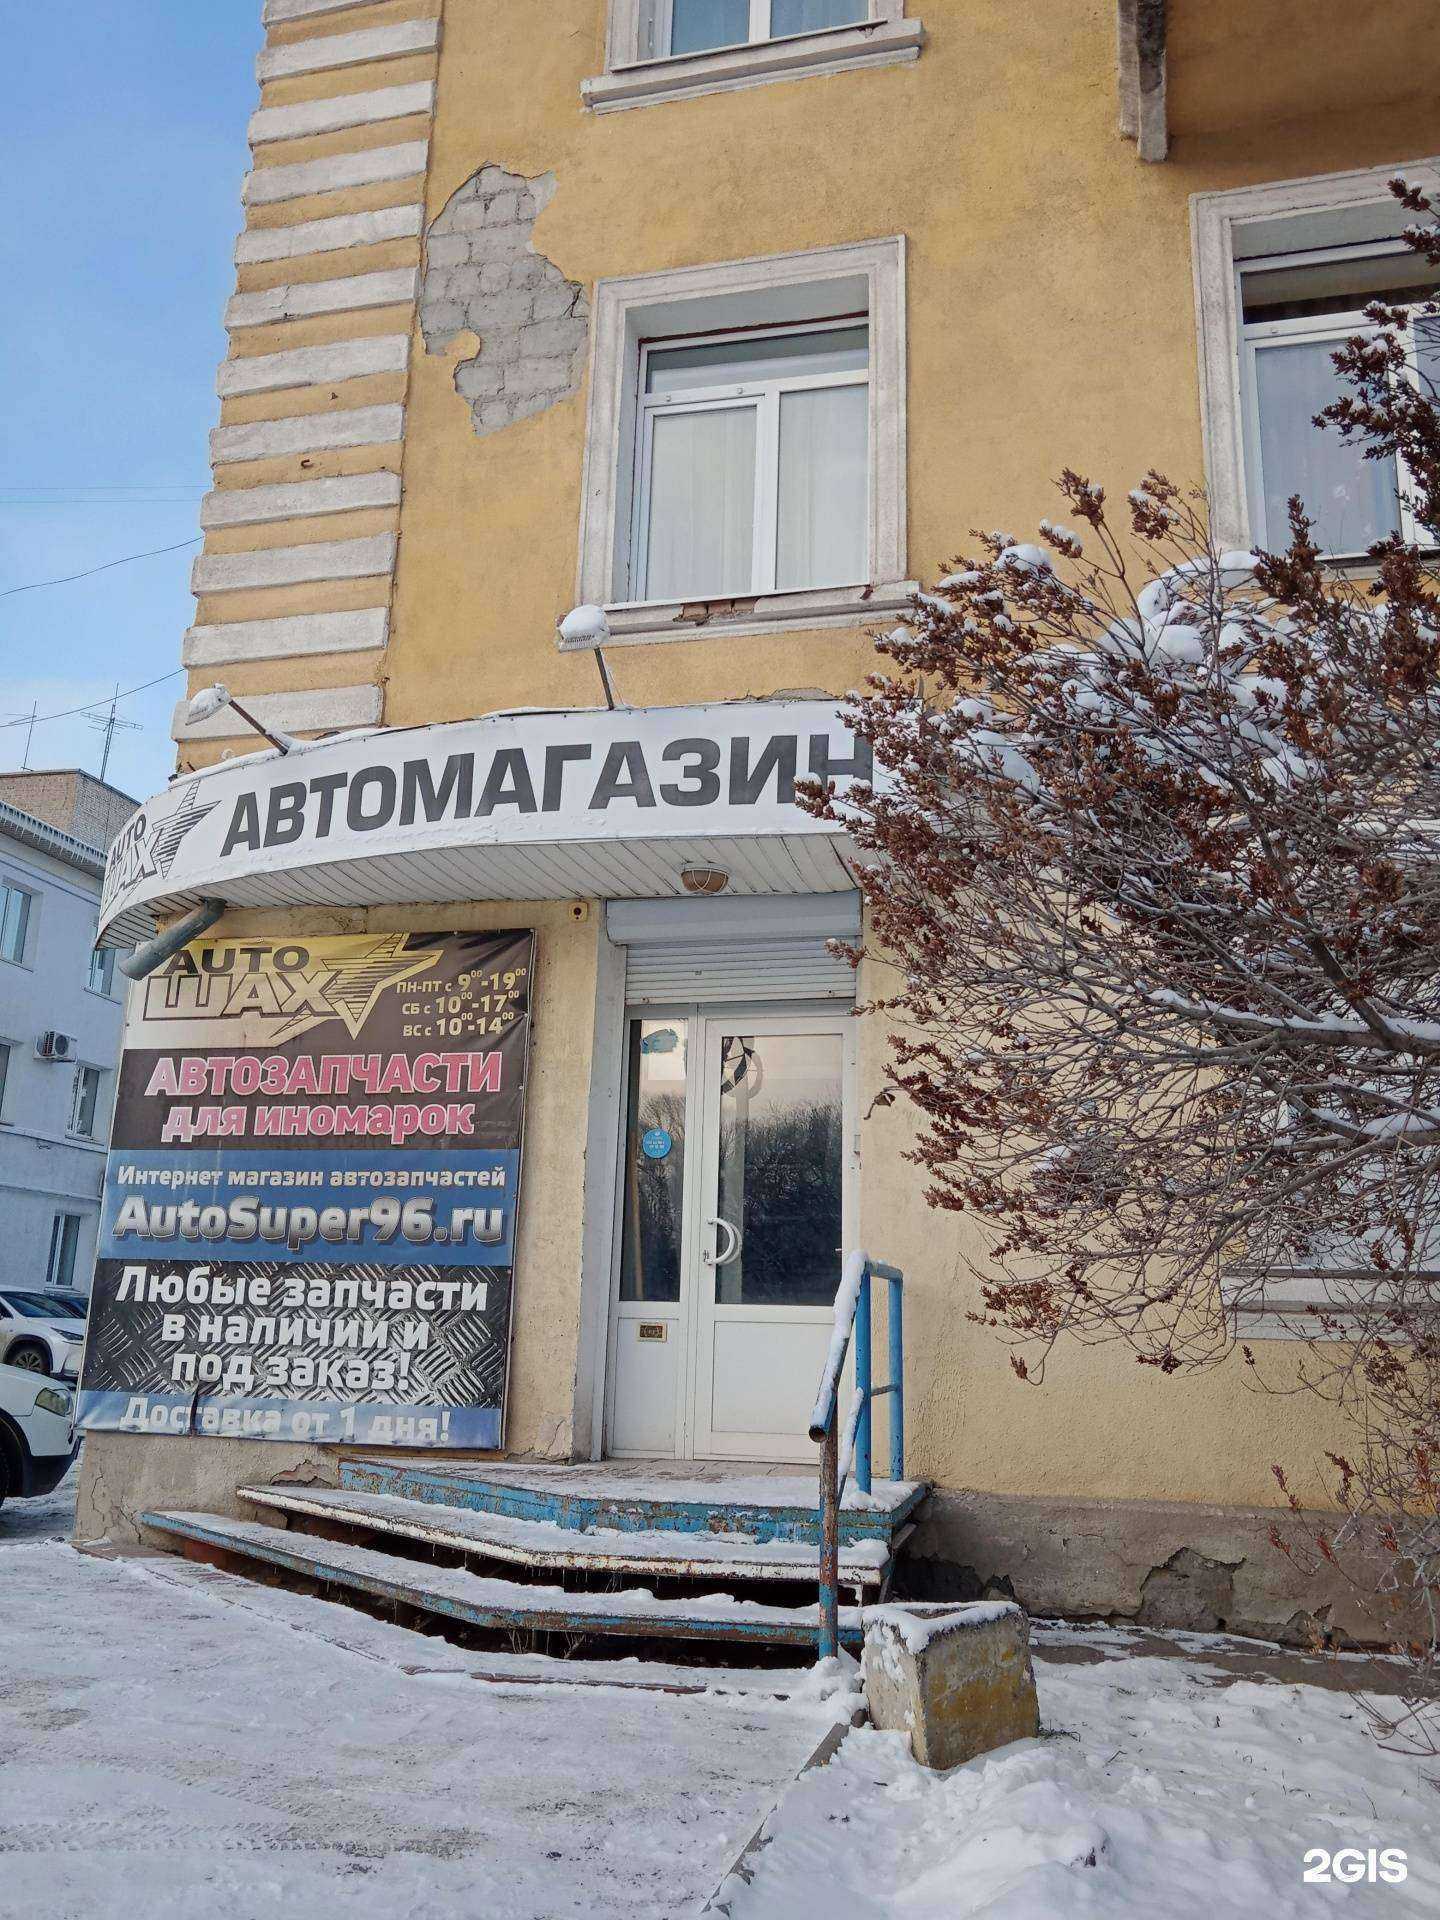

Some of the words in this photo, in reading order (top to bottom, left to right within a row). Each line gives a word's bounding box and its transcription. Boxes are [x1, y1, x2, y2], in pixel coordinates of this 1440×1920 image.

[220, 733, 873, 858] АВТОМАГАЗИН
[163, 945, 310, 975] AUTO
[143, 970, 345, 1021] ШАХ
[396, 980, 442, 993] ПН-ПТ
[402, 1002, 420, 1015] СБ
[403, 1025, 422, 1037] ВС
[144, 1051, 502, 1097] АВТОЗАПЧАСТИ
[161, 1106, 247, 1143] для
[254, 1103, 475, 1144] иномарок
[117, 1165, 223, 1190] Интернет
[228, 1167, 323, 1187] магазин
[330, 1166, 506, 1189] автозапчастей
[112, 1194, 504, 1251] AutoSuper96.ru
[115, 1265, 269, 1305] Любые
[282, 1278, 488, 1312] запчасти
[161, 1314, 185, 1342] в
[199, 1315, 389, 1348] наличии
[402, 1320, 429, 1350] и
[171, 1352, 255, 1392] под
[267, 1354, 410, 1391] заказ!
[120, 1397, 282, 1433] Доставка
[288, 1409, 330, 1433] от
[341, 1407, 355, 1436] 1
[367, 1411, 451, 1442] дня!
